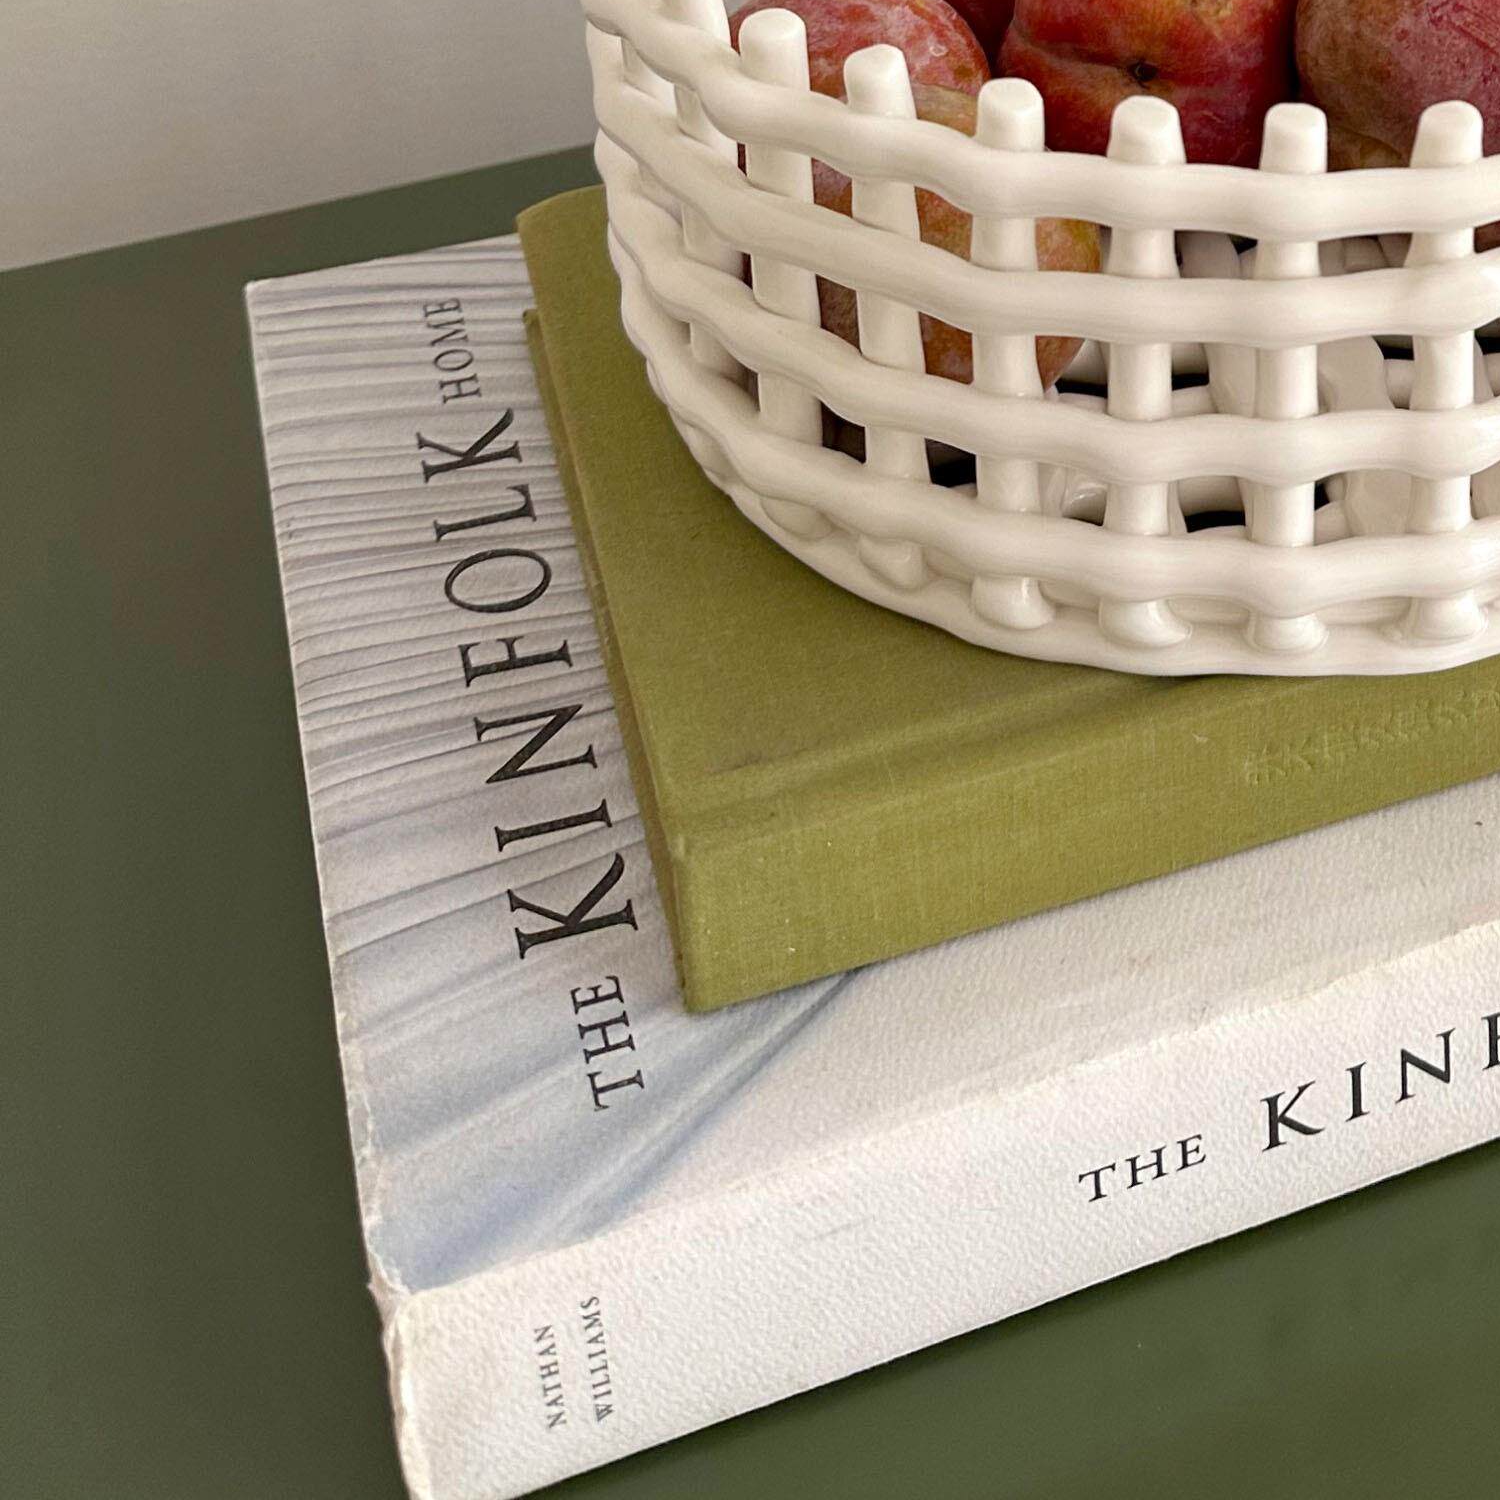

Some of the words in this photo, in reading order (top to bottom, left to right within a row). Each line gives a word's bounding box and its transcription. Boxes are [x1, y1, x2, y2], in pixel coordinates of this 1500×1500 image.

[422, 298, 482, 405] HOME
[414, 407, 639, 962] KINFOLK
[570, 974, 645, 1113] THE
[1077, 1133, 1208, 1204] THE
[533, 1324, 568, 1430] NATHAN
[580, 1296, 614, 1423] WILLIAMS
